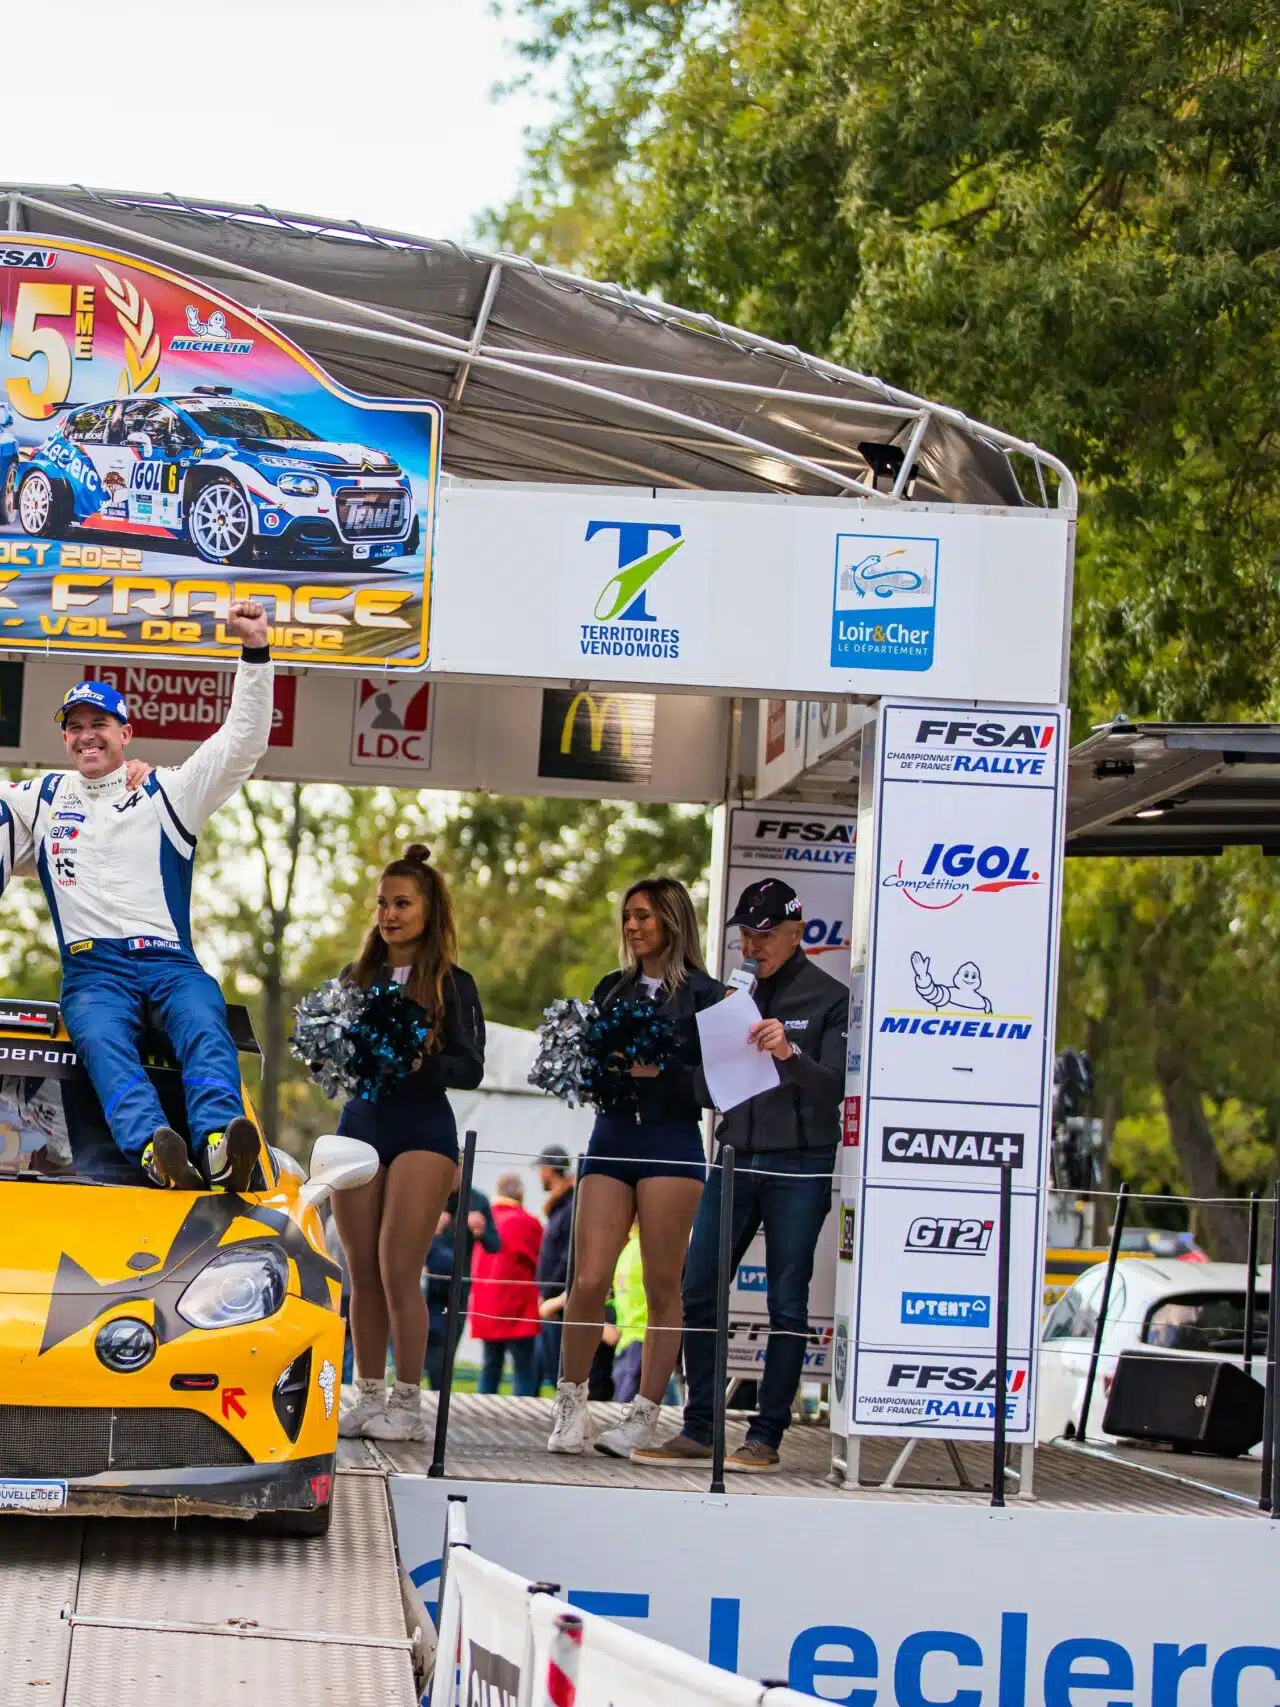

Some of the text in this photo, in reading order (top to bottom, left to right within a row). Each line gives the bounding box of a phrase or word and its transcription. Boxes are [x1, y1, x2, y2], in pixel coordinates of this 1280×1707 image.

[169, 340, 254, 354] MICHELIN
[130, 462, 177, 493] IGOL 6
[61, 547, 144, 570] 2022
[51, 573, 414, 629] FRANCE
[39, 614, 127, 641] VAL
[140, 620, 201, 643] DE
[215, 621, 345, 650] LIRE
[580, 625, 680, 643] TERRITOIRES
[838, 621, 930, 645] Loir&Cher
[580, 641, 680, 659] VENDOMOIS
[837, 642, 929, 656] LE DÉPARTEMENT
[125, 666, 236, 699] Nouvell
[125, 697, 283, 728] Républie
[915, 720, 1037, 748] FFSA
[886, 752, 955, 762] CHAMPIONNAT
[900, 761, 953, 772] DE FRANCE
[953, 755, 1046, 776] RALLYE
[50, 826, 68, 839] elf
[755, 819, 850, 843] FFSA
[784, 847, 855, 865] RALLYE
[922, 844, 1030, 880] IGOL
[882, 874, 970, 893] Compétition
[803, 918, 844, 946] OL
[879, 1017, 1033, 1040] MICHELIN
[887, 1132, 1019, 1163] CANAL+
[905, 1216, 995, 1252] GT2i
[741, 1270, 767, 1284] LPT
[906, 1299, 972, 1317] LPTENT
[858, 1395, 927, 1406] CHAMPIONNAT
[871, 1405, 924, 1416] DE FRANCE
